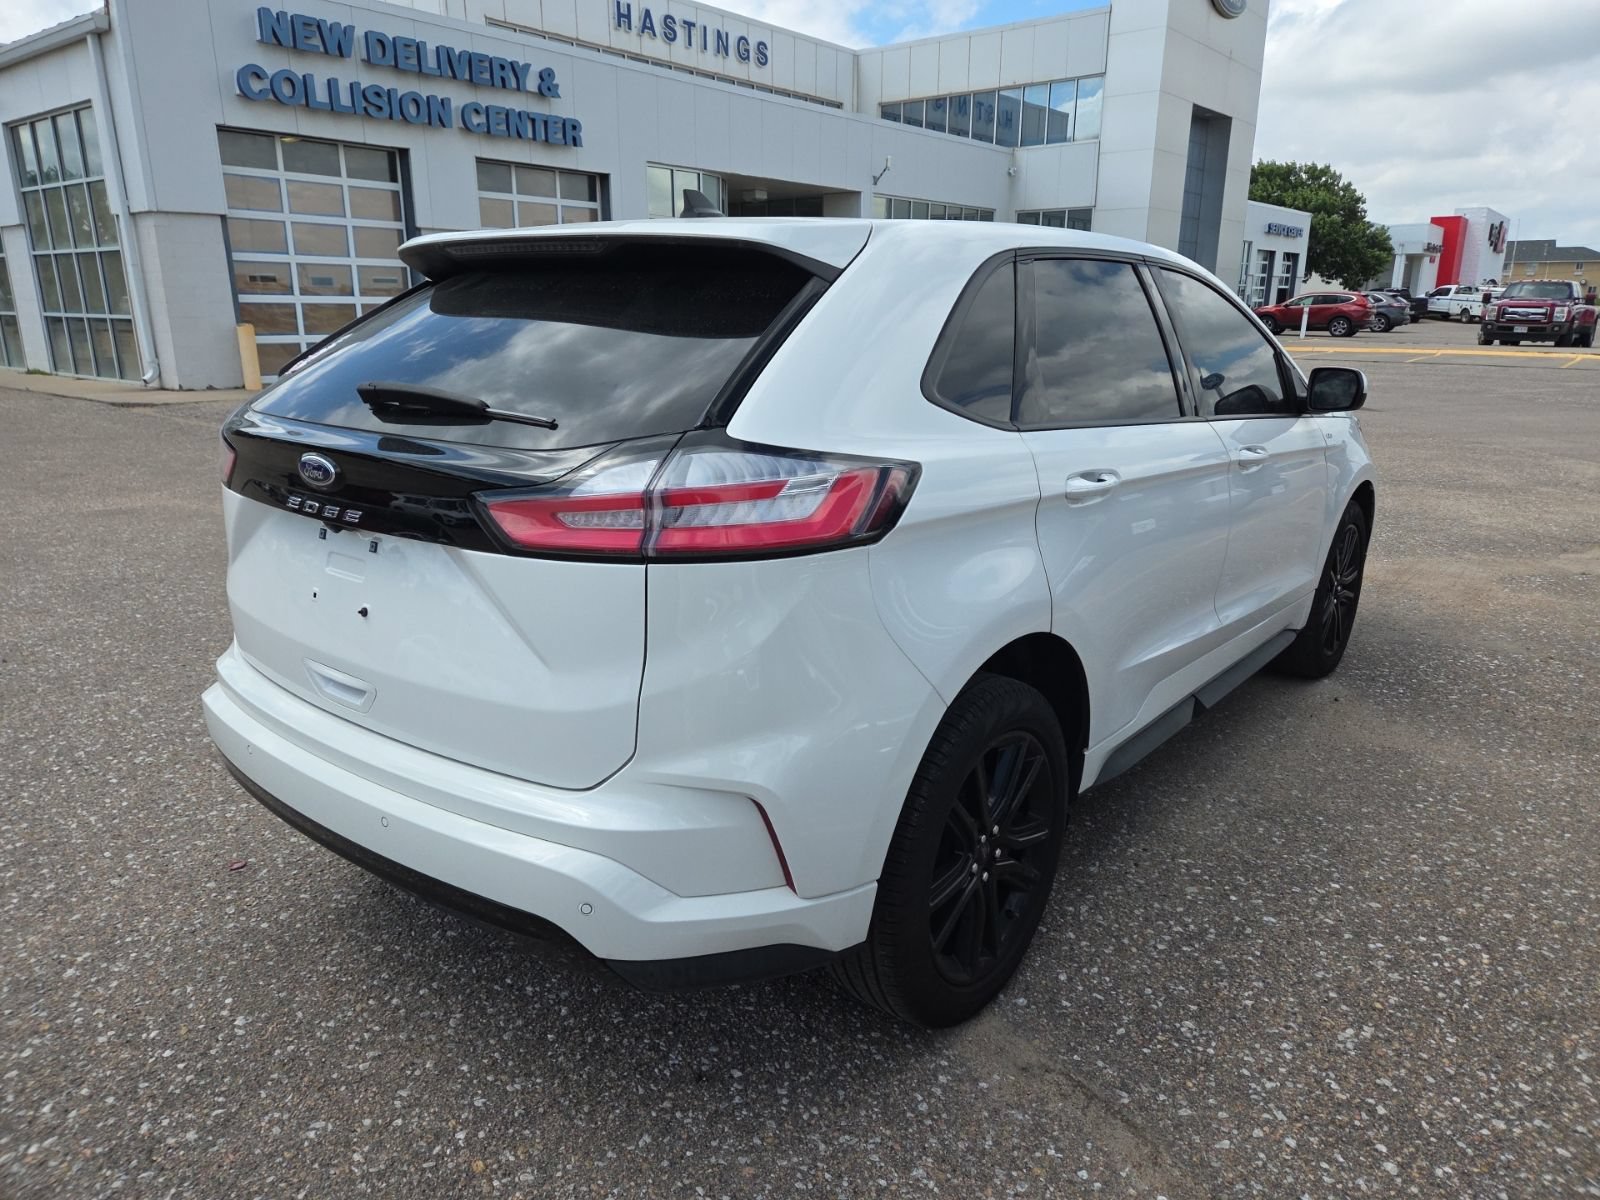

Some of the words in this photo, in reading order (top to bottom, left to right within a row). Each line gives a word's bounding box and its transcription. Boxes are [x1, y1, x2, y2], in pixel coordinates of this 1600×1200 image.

[257, 6, 355, 59] NEW
[363, 29, 531, 92] DELIVERY
[537, 66, 561, 99] &
[615, 0, 769, 67] HASTINGS
[236, 63, 453, 129] COLLISION
[461, 101, 583, 148] CENTER
[286, 495, 363, 523] EDGE
